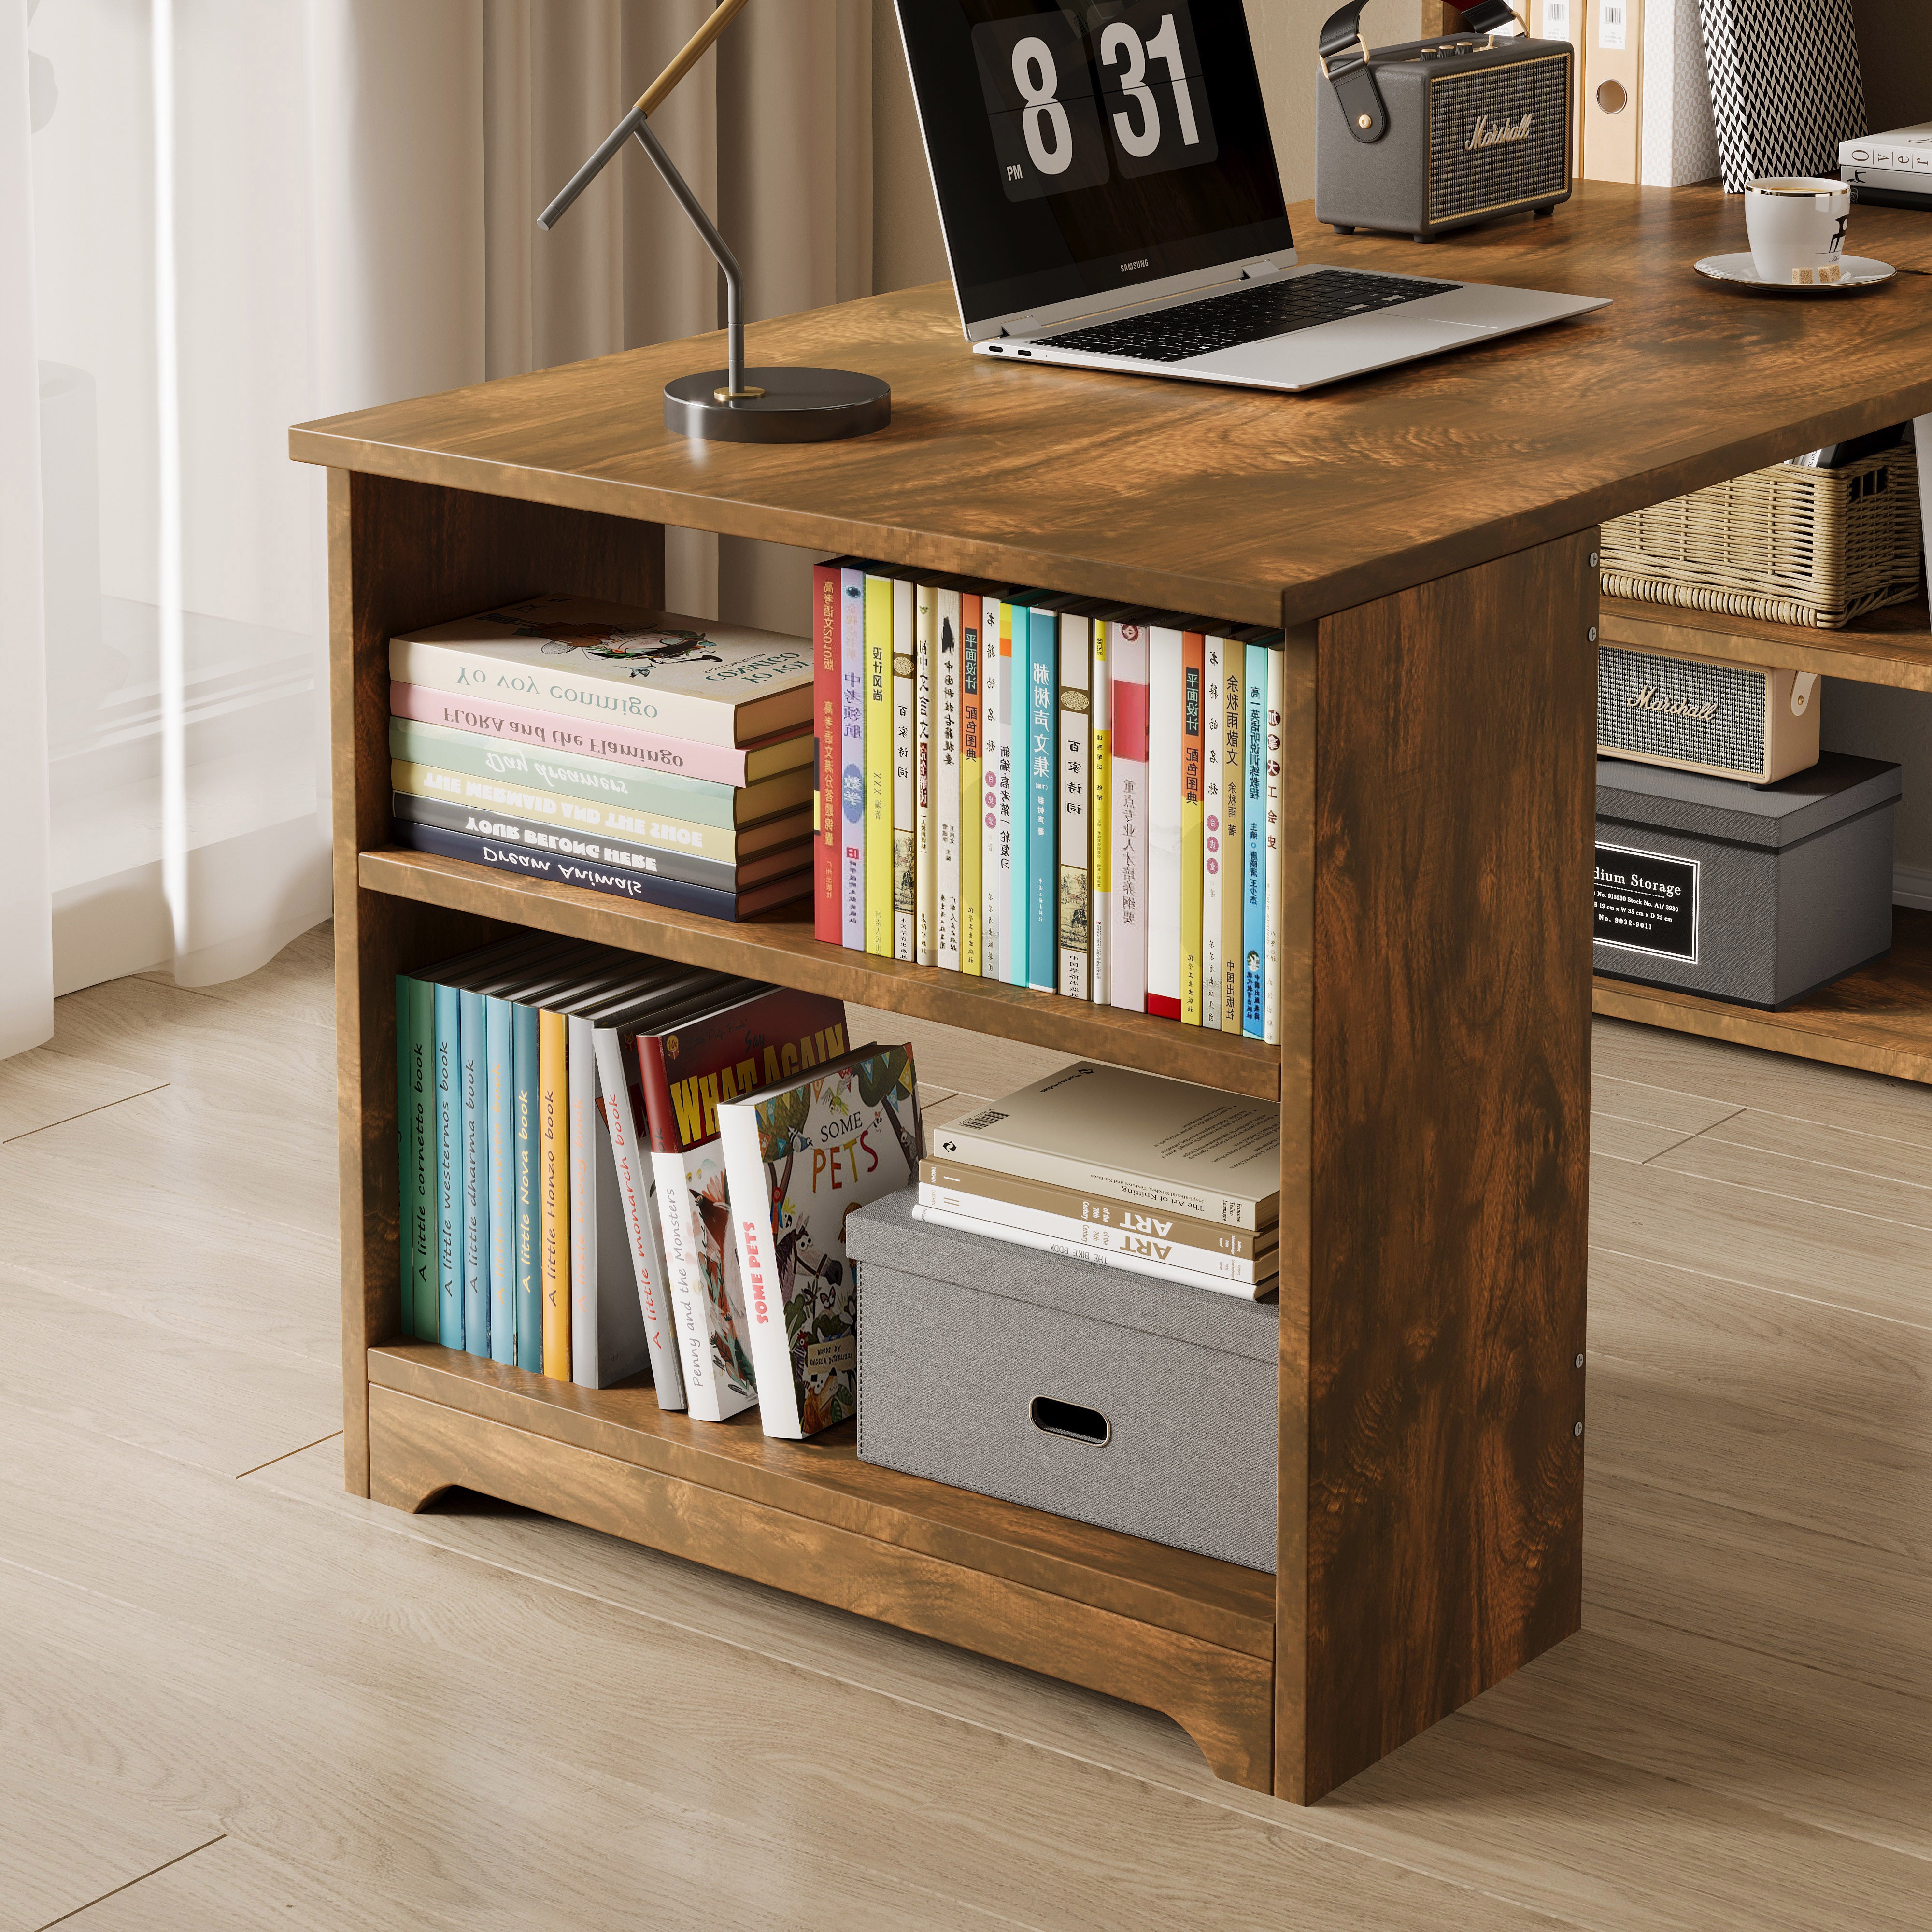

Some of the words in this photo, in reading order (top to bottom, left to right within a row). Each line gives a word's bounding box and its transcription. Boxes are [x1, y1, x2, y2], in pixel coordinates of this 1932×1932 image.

[1011, 36, 1072, 175] 8
[1100, 14, 1200, 158] 31
[1464, 114, 1532, 151] Marshall
[1007, 165, 1023, 181] PM
[1120, 259, 1149, 272] SAMSUNG
[1628, 685, 1719, 720] Marshall
[1607, 893, 1626, 902] 913530
[1627, 897, 1642, 906] Stock
[1631, 874, 1681, 897] Storage
[1599, 914, 1611, 922] No.
[1615, 918, 1652, 930] 9032-9011
[744, 1030, 765, 1054] Say
[414, 1043, 423, 1093] book
[440, 1042, 448, 1091] book
[466, 1059, 474, 1109] book
[492, 1063, 501, 1113] book
[670, 1058, 758, 1147] WHAT
[763, 1023, 845, 1086] AGAIN
[518, 1089, 528, 1140] book
[544, 1090, 554, 1140] book
[574, 1097, 583, 1148] book
[608, 1094, 624, 1146] book
[821, 1111, 863, 1142] SOME
[416, 1103, 425, 1195] cornetto
[442, 1101, 451, 1209] westernos
[468, 1120, 476, 1206] dharma
[813, 1129, 878, 1194] PETS
[494, 1123, 503, 1217] cornetto
[521, 1151, 529, 1205] Nova
[547, 1151, 555, 1218] Honzo
[1091, 1174, 1113, 1182] Surfaces
[1124, 1182, 1147, 1191] Textures
[576, 1158, 587, 1223] Droog
[620, 1156, 645, 1257] monarch
[1122, 1186, 1157, 1201] Knitting
[1149, 1187, 1170, 1196] Stitches,
[1159, 1194, 1168, 1202] of
[1170, 1192, 1204, 1204] Inspirational
[1171, 1197, 1185, 1207] Art
[1188, 1202, 1204, 1211] The
[666, 1189, 684, 1261] Monsters
[1081, 1201, 1090, 1220] Century
[1119, 1212, 1173, 1237] ART
[417, 1206, 426, 1255] little
[443, 1220, 452, 1269] little
[468, 1216, 477, 1265] little
[520, 1214, 530, 1265] little
[743, 1222, 761, 1269] PETS
[1120, 1236, 1172, 1260] ART
[494, 1227, 504, 1277] little
[547, 1228, 556, 1279] little
[576, 1234, 585, 1285] little
[1050, 1243, 1069, 1255] BOOK
[1073, 1249, 1090, 1260] BIKE
[1094, 1254, 1108, 1264] THE
[419, 1265, 426, 1282] A
[444, 1280, 452, 1297] A
[470, 1277, 478, 1293] A
[522, 1275, 530, 1293] A
[678, 1268, 688, 1293] the
[496, 1287, 504, 1304] A
[549, 1290, 556, 1307] A
[577, 1295, 585, 1313] A
[641, 1268, 657, 1320] little
[749, 1271, 769, 1324] SOME
[681, 1301, 694, 1331] and
[653, 1331, 662, 1350] A
[689, 1338, 703, 1387] Penny
